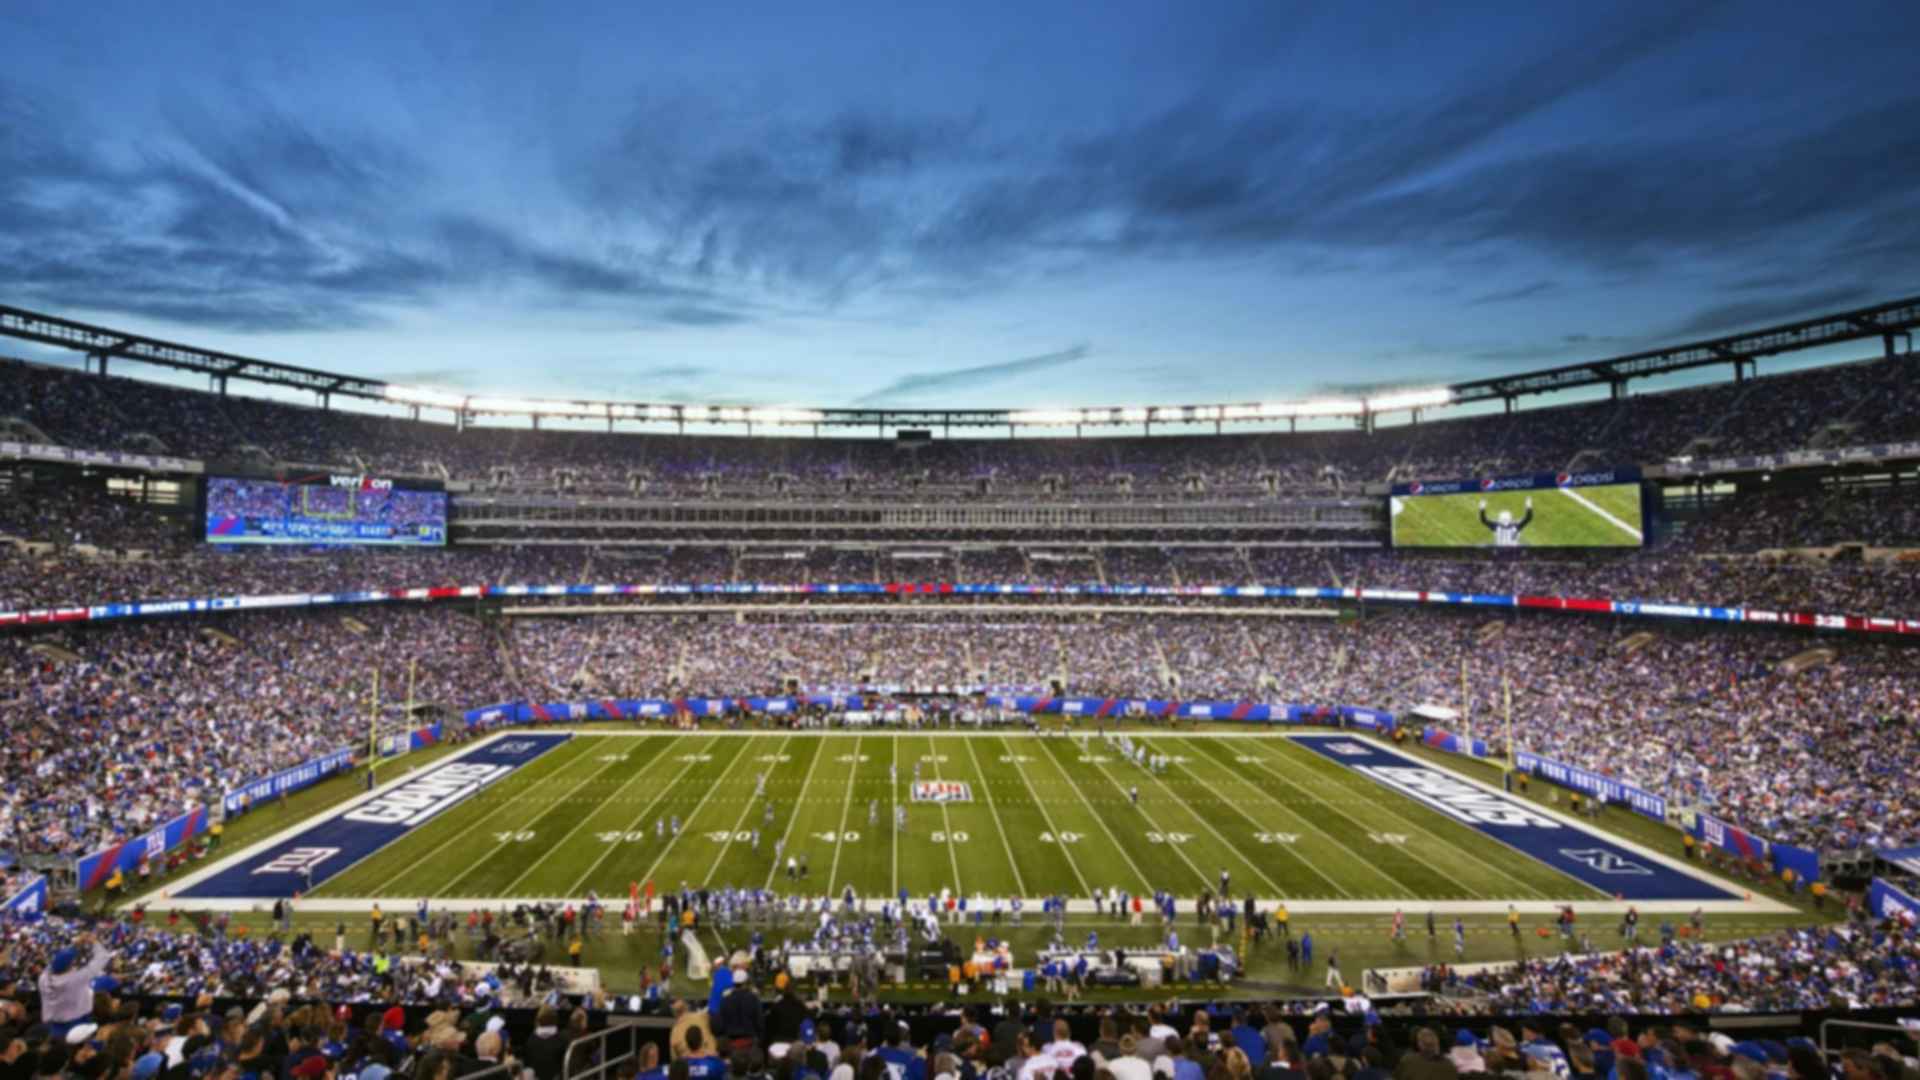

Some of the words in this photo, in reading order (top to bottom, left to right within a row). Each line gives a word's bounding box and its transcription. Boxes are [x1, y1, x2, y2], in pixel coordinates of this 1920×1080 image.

[330, 474, 392, 490] verizon
[1494, 478, 1533, 490] pepsi
[1572, 473, 1614, 486] pepsi
[343, 762, 498, 824] GIANTS
[821, 830, 860, 843] 40
[931, 830, 968, 843] 50
[1039, 830, 1078, 843] 40
